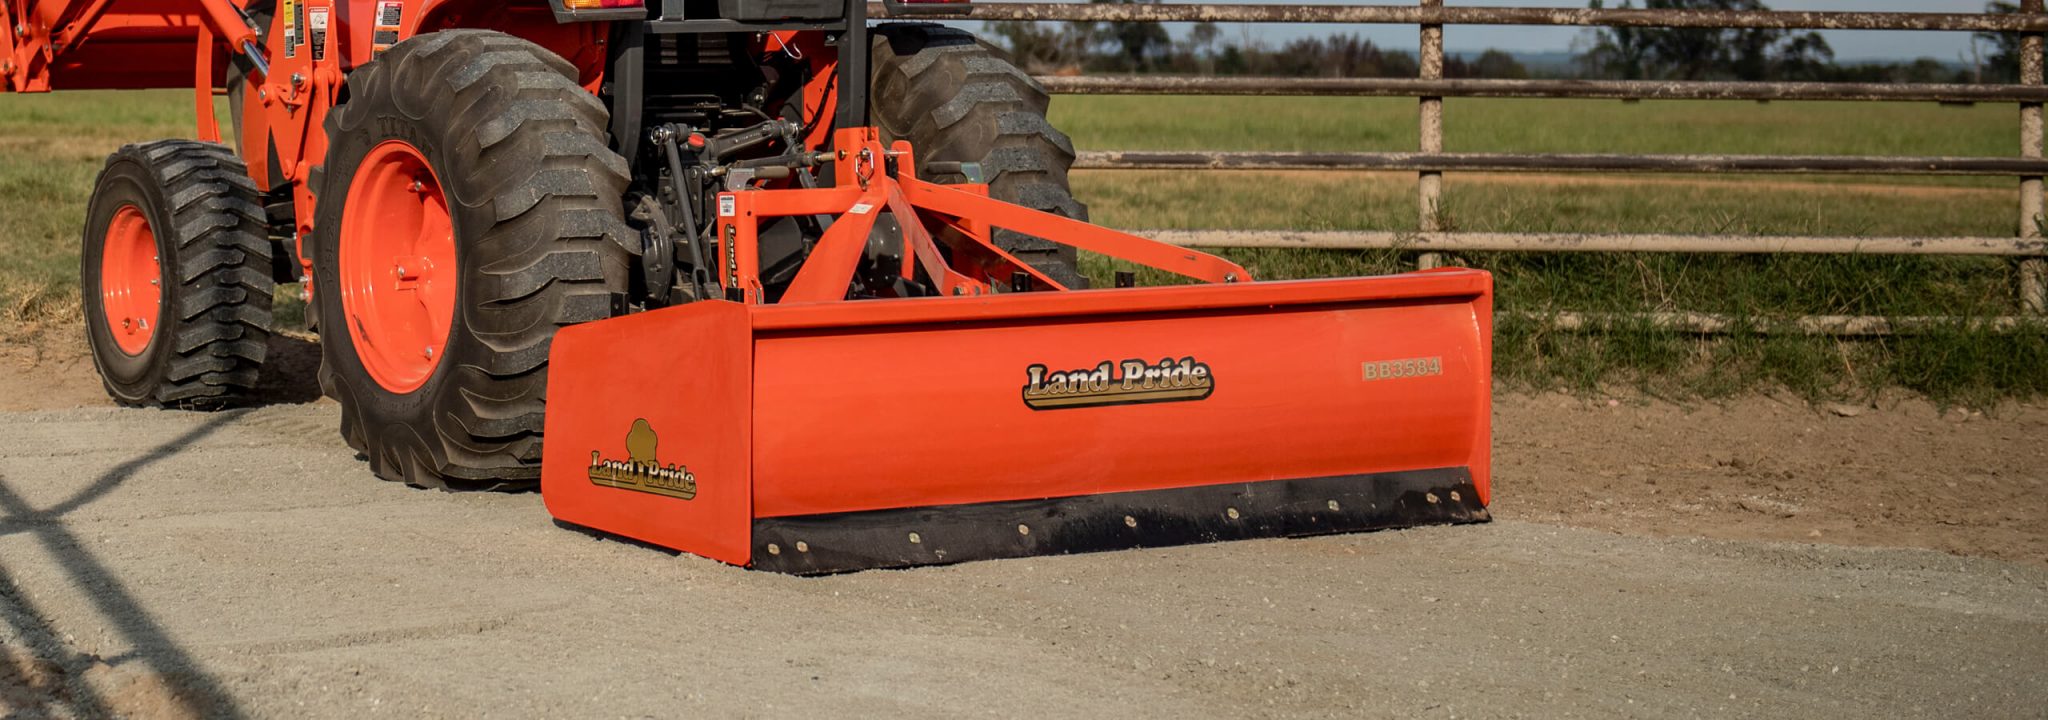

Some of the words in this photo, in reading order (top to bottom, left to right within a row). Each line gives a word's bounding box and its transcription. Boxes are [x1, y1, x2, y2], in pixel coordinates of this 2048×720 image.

[725, 224, 739, 271] Land
[1028, 361, 1111, 396] Land
[1120, 355, 1208, 390] Pride
[1363, 357, 1441, 380] BB3584
[590, 450, 635, 481] Land
[647, 460, 695, 491] Pride
